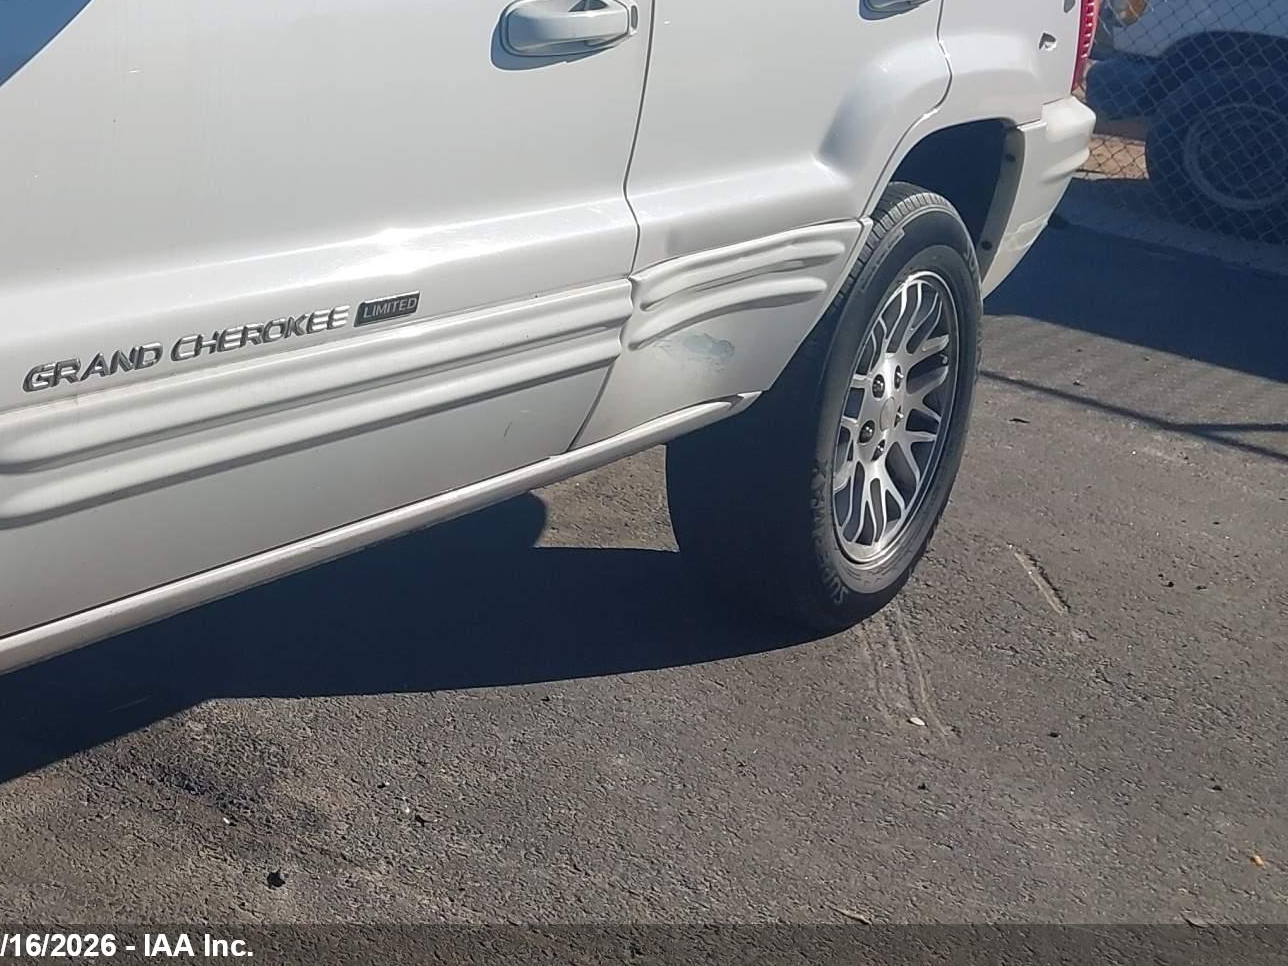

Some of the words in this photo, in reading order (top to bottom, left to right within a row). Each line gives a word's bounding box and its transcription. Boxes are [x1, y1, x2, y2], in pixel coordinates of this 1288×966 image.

[23, 341, 164, 392] GRAND
[170, 304, 351, 363] CHEROKEE
[362, 296, 419, 320] LIMITED
